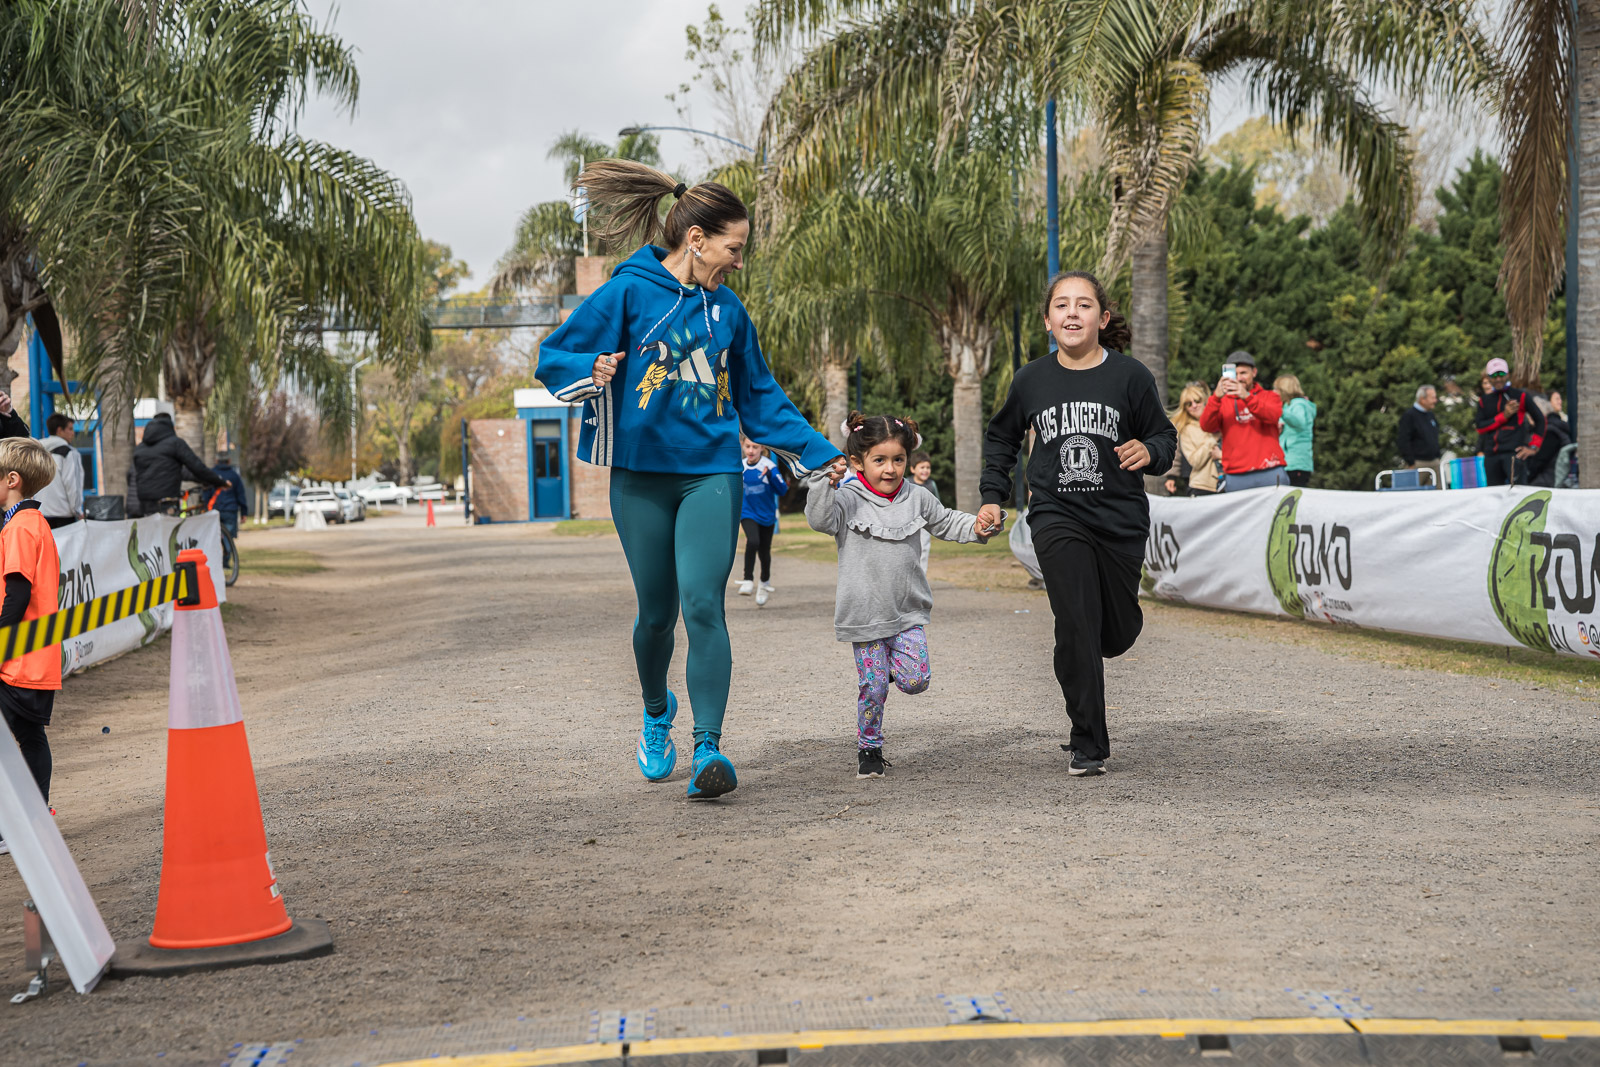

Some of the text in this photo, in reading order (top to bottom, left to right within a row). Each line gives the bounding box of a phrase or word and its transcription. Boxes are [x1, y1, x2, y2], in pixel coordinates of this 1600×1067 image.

[1036, 401, 1120, 444] LOS ANGELES
[1070, 448, 1090, 468] LA
